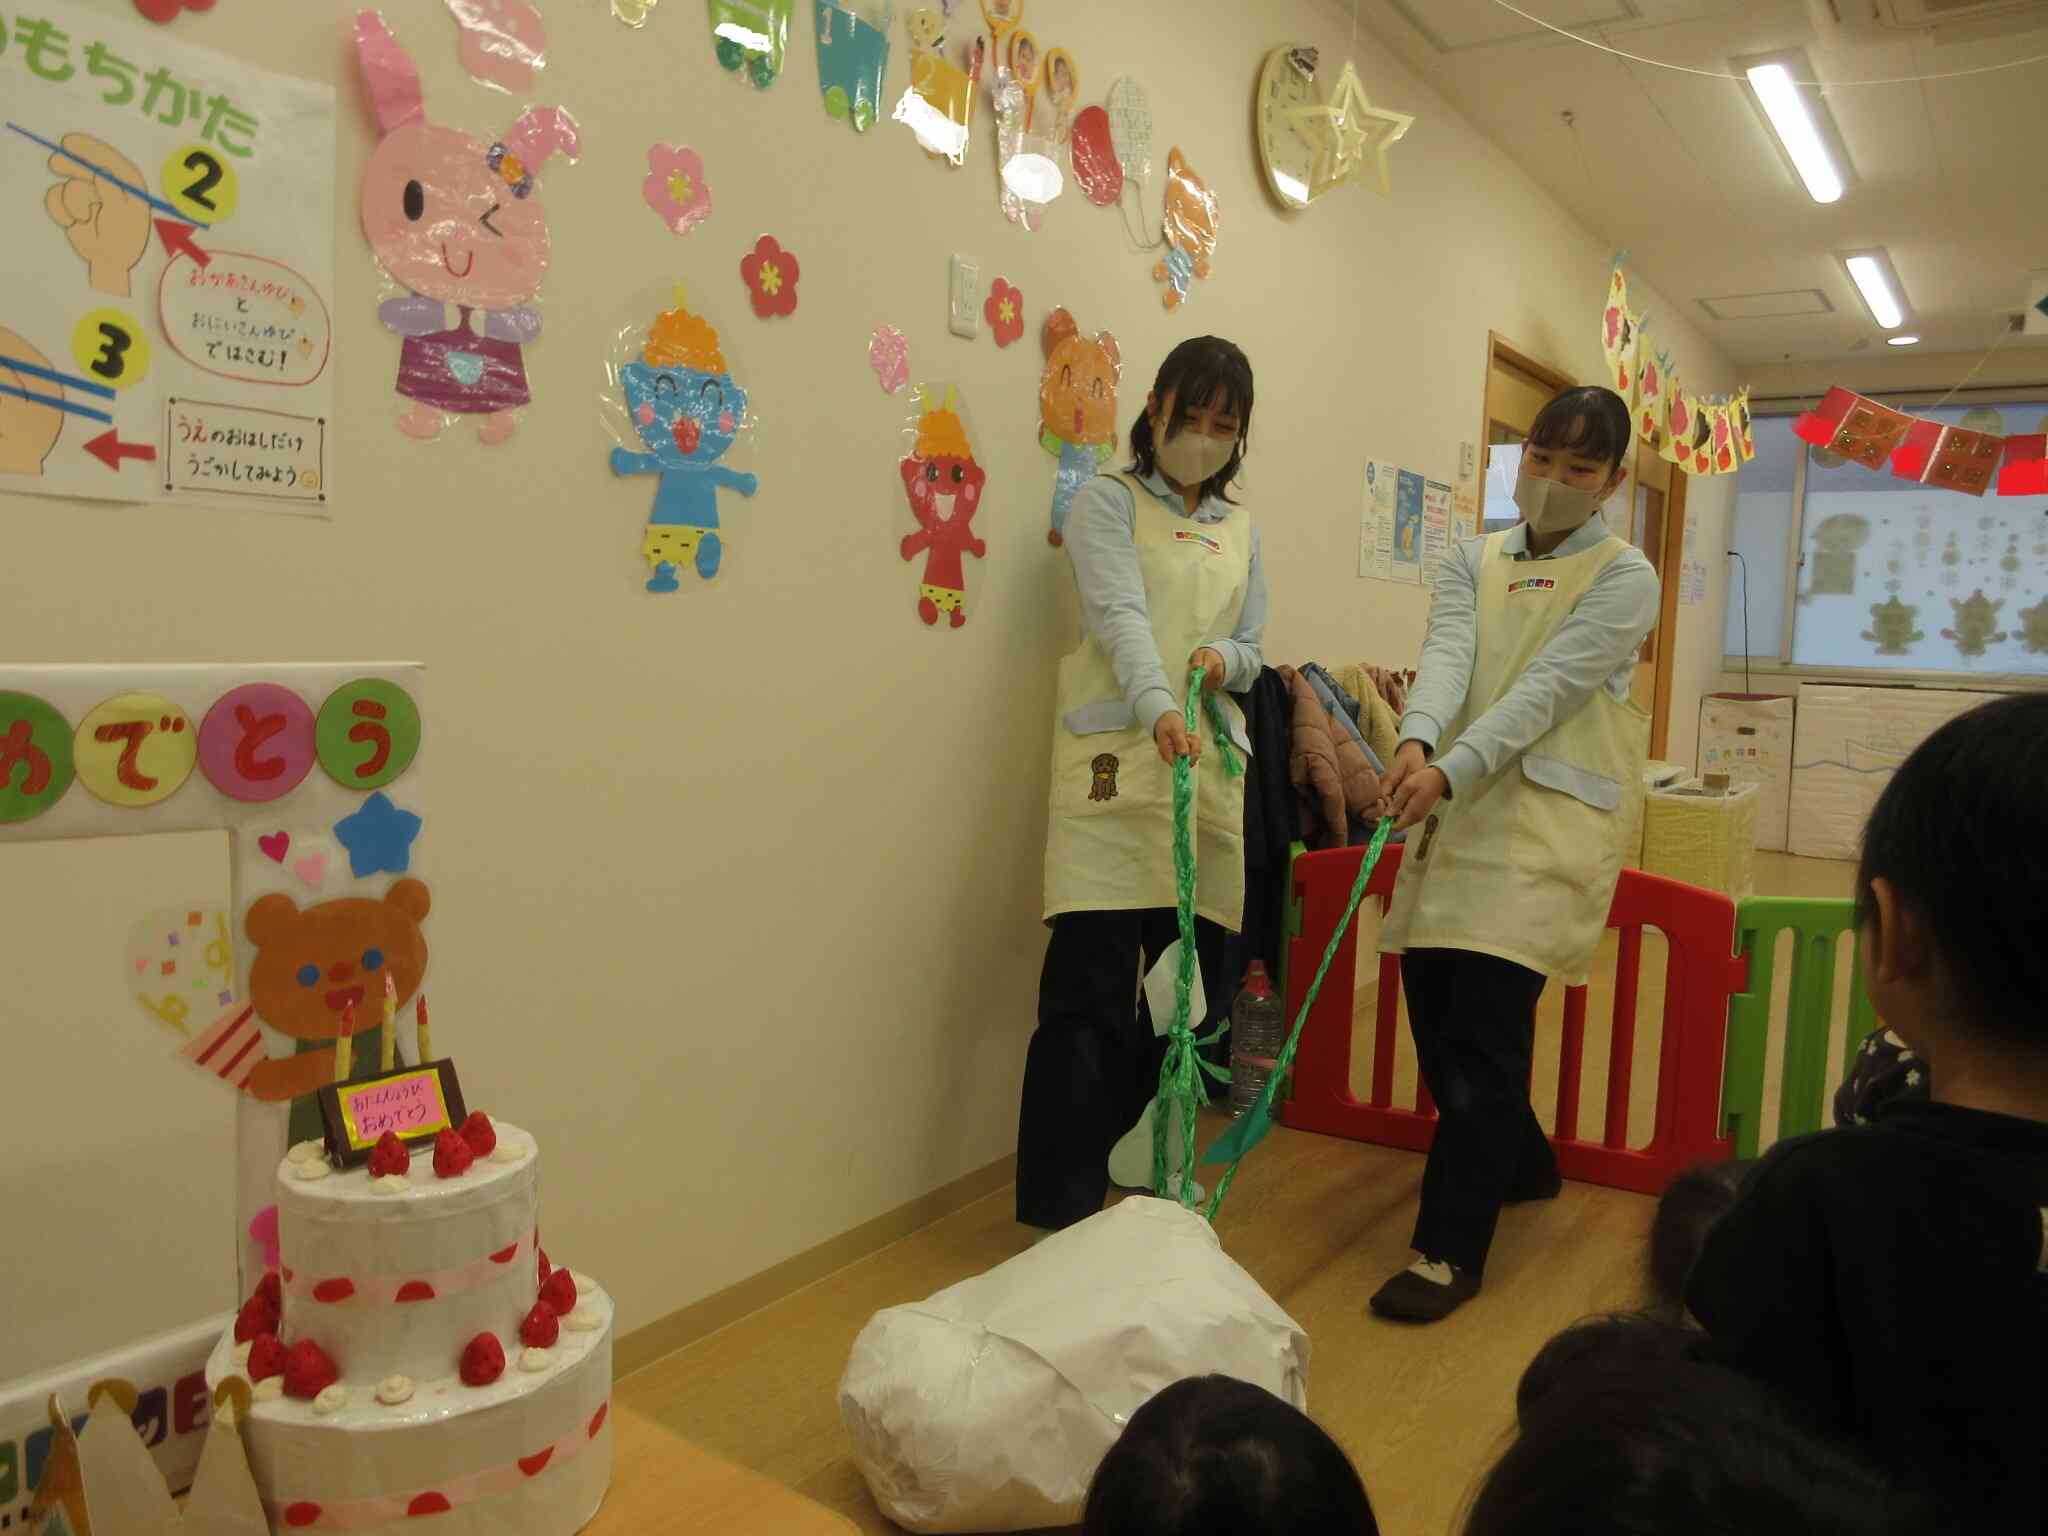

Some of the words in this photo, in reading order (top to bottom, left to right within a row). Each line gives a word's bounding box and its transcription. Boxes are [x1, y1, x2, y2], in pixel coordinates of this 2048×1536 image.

[0, 16, 259, 158] もちかた
[181, 151, 223, 211] 2
[236, 298, 249, 313] と
[90, 322, 132, 379] 3
[177, 415, 304, 453] うえのおはしだけ
[187, 453, 297, 487] うごかしてみよう
